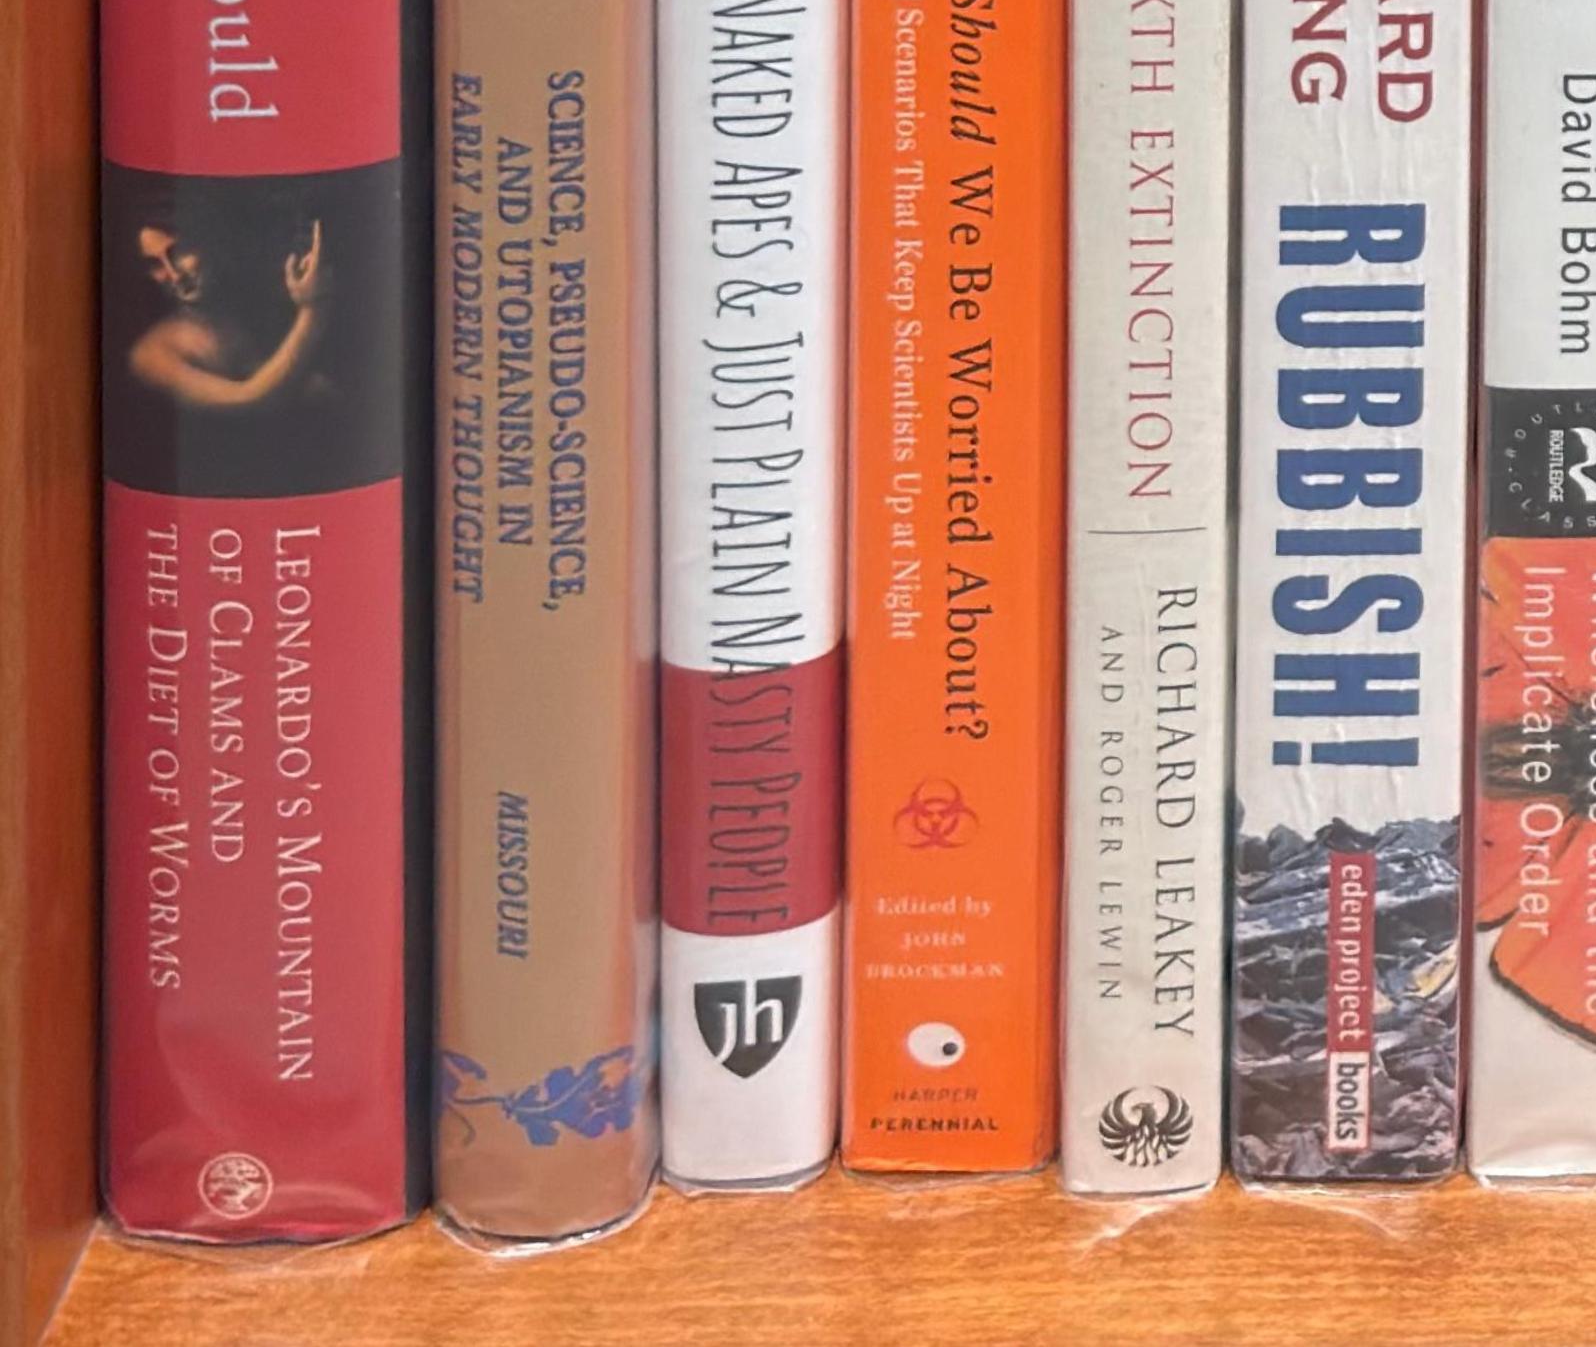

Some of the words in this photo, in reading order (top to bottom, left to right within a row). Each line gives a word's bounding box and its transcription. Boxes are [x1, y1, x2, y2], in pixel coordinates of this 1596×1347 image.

[450, 74, 482, 195] EARLY
[894, 4, 924, 152] Scenarios
[496, 137, 532, 226] AND
[542, 70, 585, 249] SCIENCE,
[711, 161, 802, 259] APES
[894, 161, 924, 224] That
[949, 165, 994, 245] We
[451, 208, 482, 381] MODERN
[716, 280, 802, 318] &
[886, 237, 924, 311] Keep
[949, 264, 992, 321] Be
[1128, 131, 1175, 499] EXTINCTION
[496, 239, 533, 493] UTOPIANISM
[703, 332, 803, 432] JUST
[888, 322, 922, 465] Scientists
[542, 260, 586, 612] PSEUDO-SCIENCE,
[885, 473, 921, 516] Up
[946, 339, 995, 544] Worried
[1272, 203, 1426, 768] RUBBISH!
[1550, 430, 1563, 502] ROUTLEDGE
[451, 391, 483, 603] THOUGHT
[498, 508, 533, 547] IN
[711, 449, 803, 598] PLAIN
[890, 523, 920, 553] at
[146, 524, 181, 613] THE
[207, 527, 244, 586] OF
[883, 562, 920, 640] Night
[146, 627, 187, 737] DIET
[207, 600, 253, 758] CLAMS
[708, 613, 804, 755] NASTY
[945, 564, 993, 741] About?
[1101, 626, 1122, 705] AND
[1155, 585, 1198, 826] RICHARD
[1518, 566, 1566, 785] Implicate
[148, 750, 181, 807] OF
[208, 768, 245, 864] AND
[1099, 729, 1122, 856] ROGER
[146, 815, 189, 991] WORMS
[495, 791, 530, 958] MISSOURI
[707, 770, 802, 926] PEOPLE
[1341, 864, 1361, 928] eden
[1518, 803, 1564, 938] Order
[275, 833, 322, 1084] MOUNTAIN
[1099, 882, 1120, 1000] LEWIN
[1153, 857, 1194, 1039] LEAKEY
[1335, 933, 1362, 1042] project
[870, 1117, 998, 1131] PERENNIAL
[893, 1088, 978, 1101] HARPER
[1335, 1062, 1361, 1141] books
